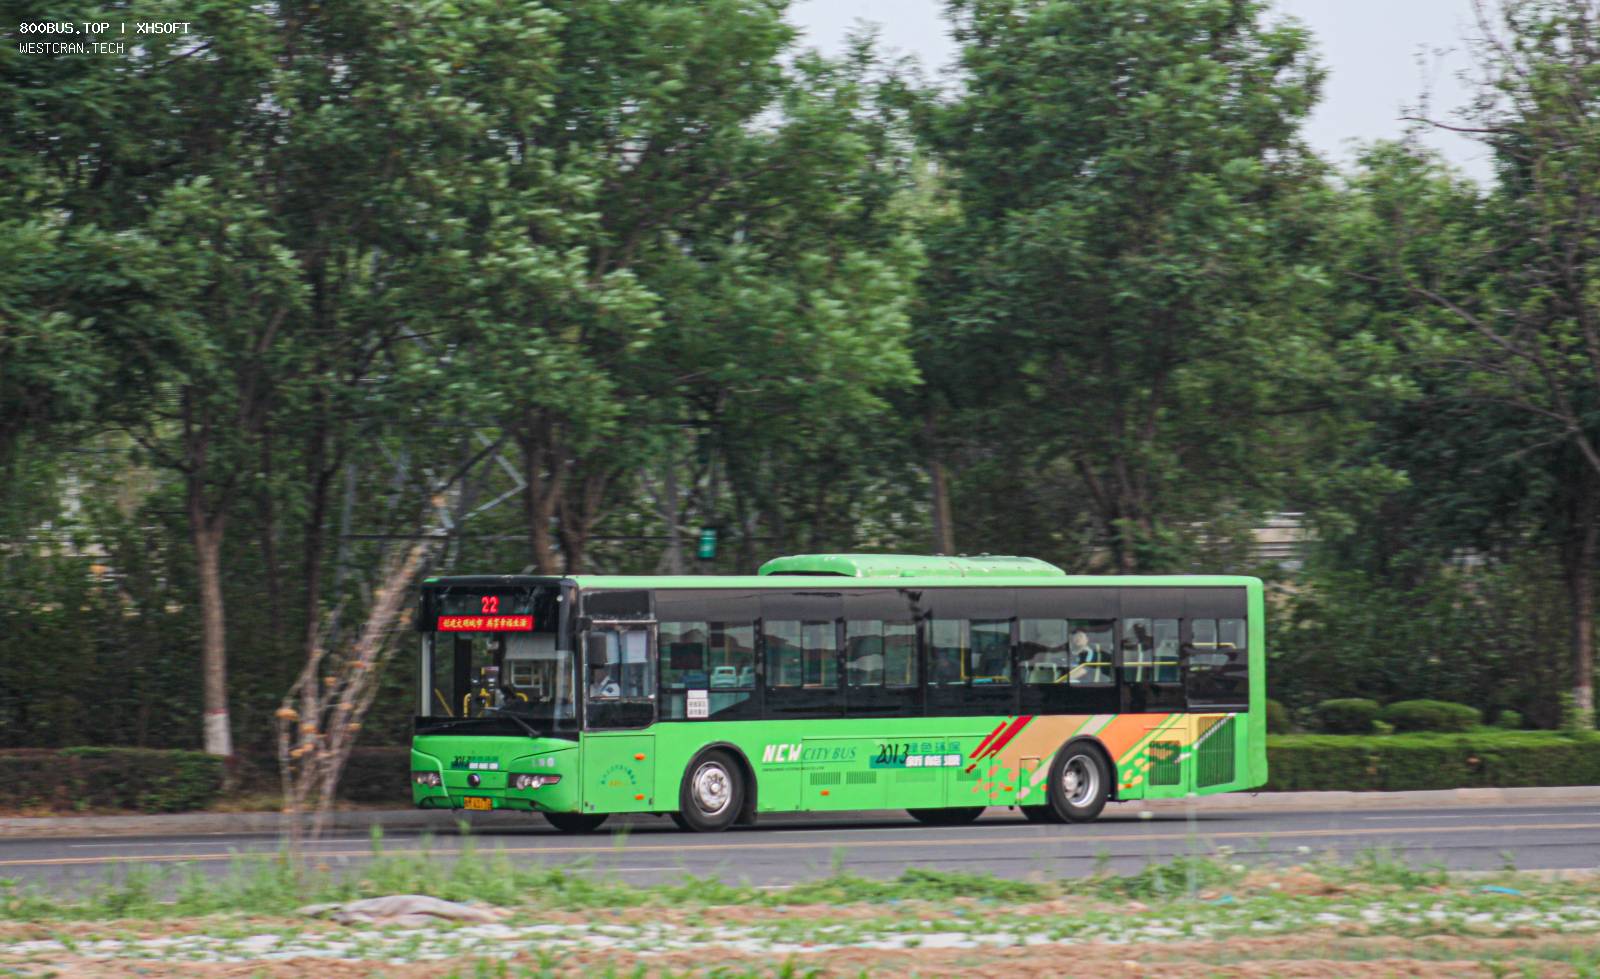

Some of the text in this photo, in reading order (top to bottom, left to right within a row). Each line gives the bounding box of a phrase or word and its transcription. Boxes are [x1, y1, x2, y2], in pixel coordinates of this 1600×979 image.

[481, 596, 499, 614] 22
[803, 747, 829, 761] CITY
[831, 746, 857, 760] BUS
[875, 743, 909, 764] 2013
